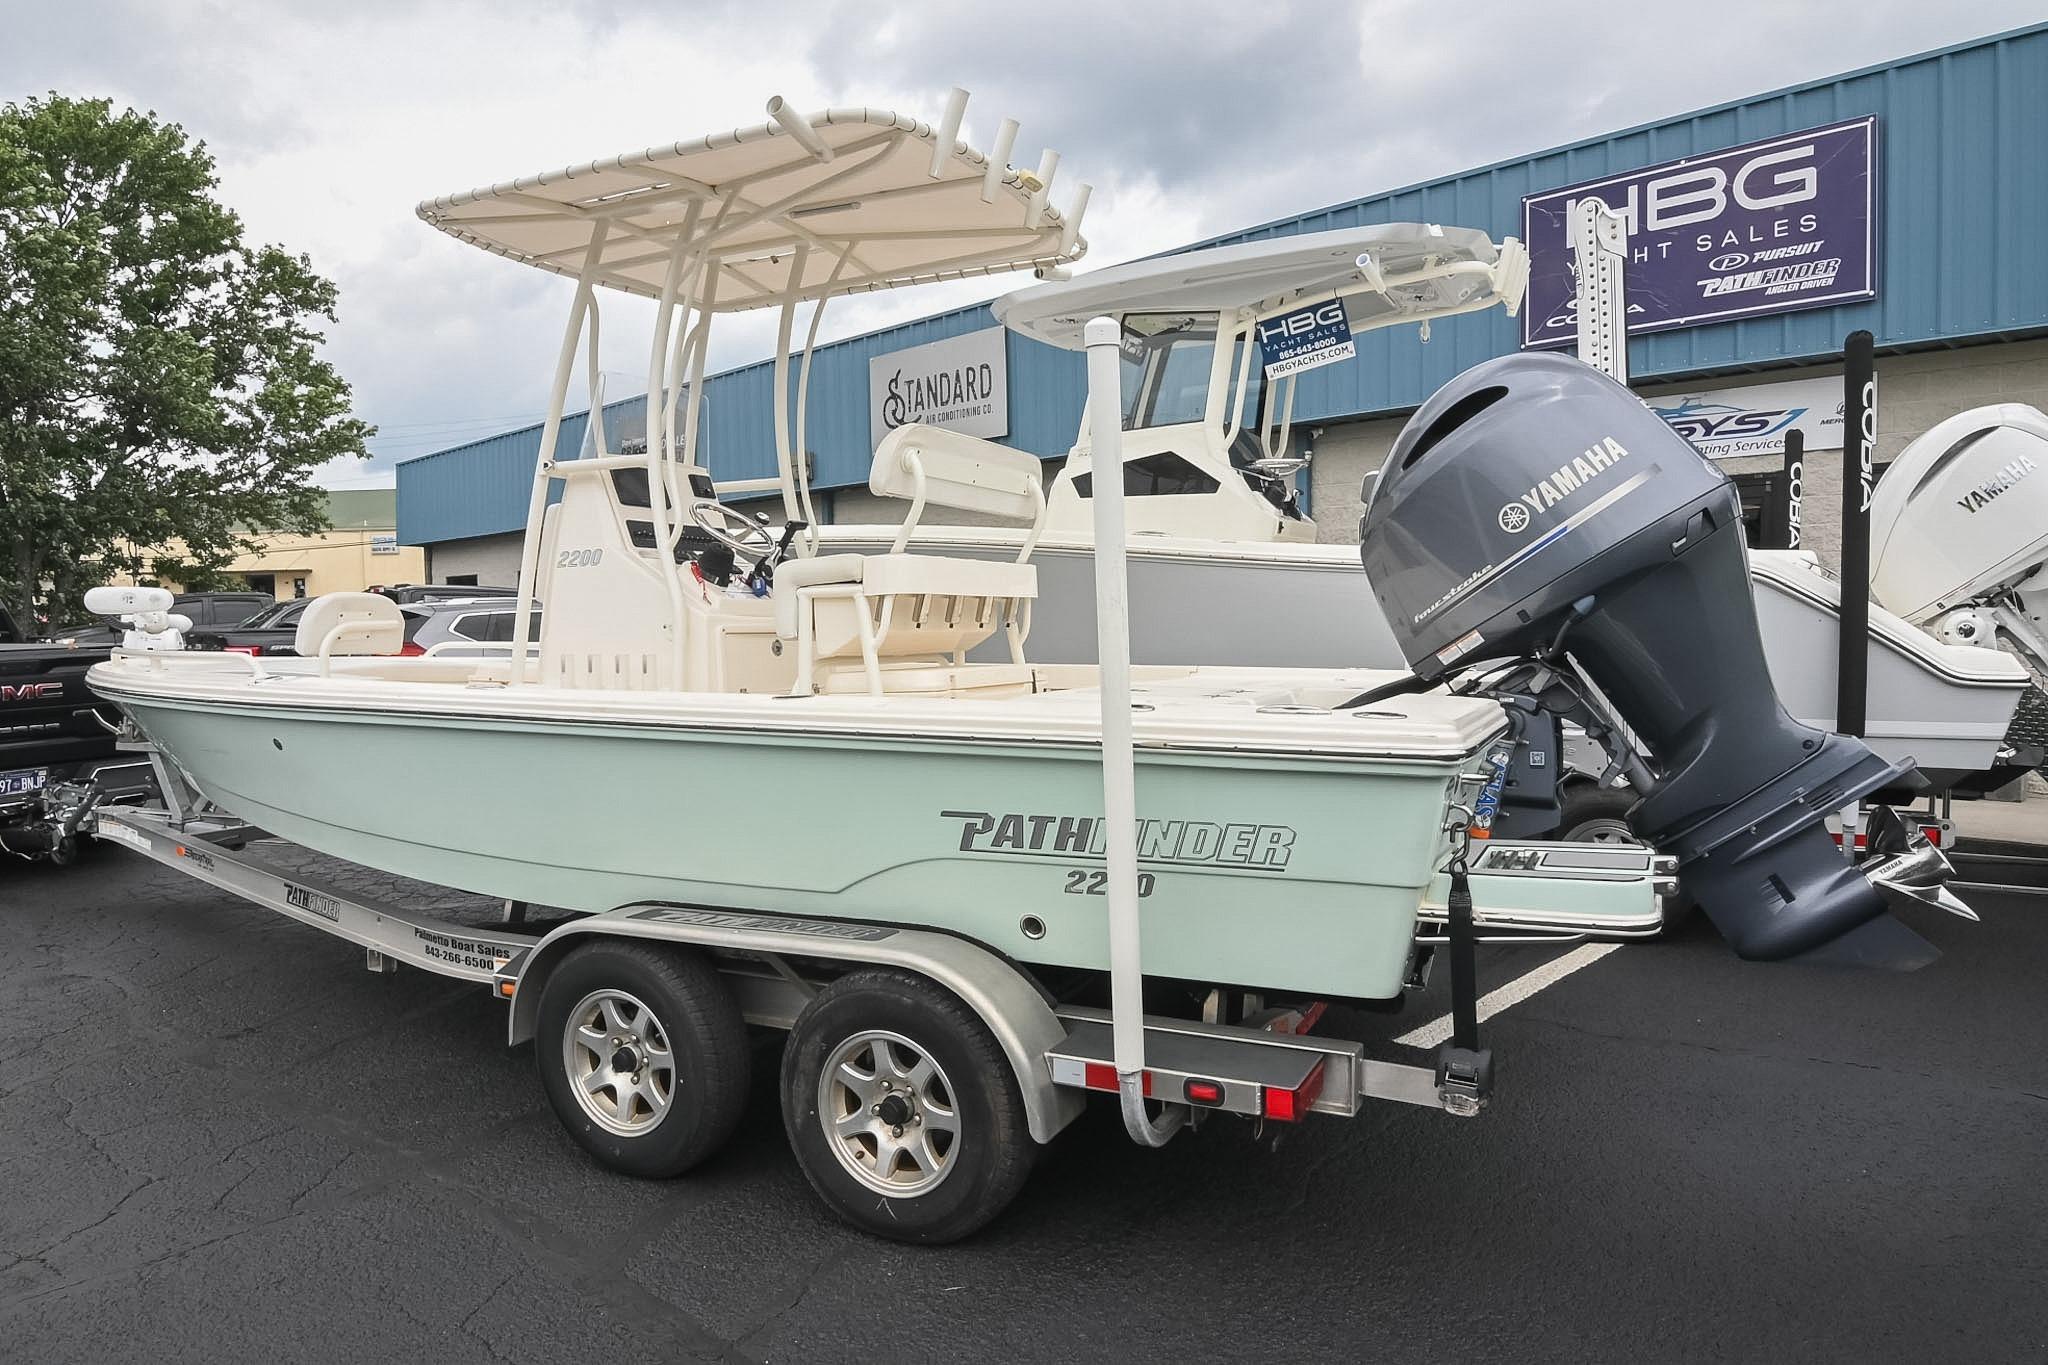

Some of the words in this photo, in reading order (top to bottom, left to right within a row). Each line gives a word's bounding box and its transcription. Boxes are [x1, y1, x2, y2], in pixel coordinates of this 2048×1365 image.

[1566, 144, 1817, 249] HBG
[1567, 242, 1673, 275] YHT
[1696, 214, 1818, 252] SALES
[1752, 240, 1825, 263] PURSUIT
[1696, 257, 1841, 298] PATHFINDER
[1765, 282, 1800, 296] ANGLER
[1801, 277, 1835, 290] DRIVEN
[1260, 303, 1344, 344] HBG
[1264, 336, 1303, 352] YACHT
[1308, 323, 1346, 340] SALES
[1272, 345, 1350, 375] HBGYACHTS.COM
[1278, 336, 1337, 360] 865-643-8000
[882, 362, 993, 430] STANDARD
[925, 414, 937, 425] AIR
[937, 405, 981, 423] CONDITIONING
[982, 403, 994, 415] CO.
[1860, 380, 1874, 513] COBIA
[1520, 436, 1629, 516] YAMAHA
[1957, 455, 2038, 514] YAMAHA
[1789, 461, 1803, 549] COBIA
[556, 548, 604, 569] 2200
[1414, 564, 1494, 624] fourstroke
[21, 775, 46, 791] BNJP
[940, 810, 1298, 868] PATHNDER
[1064, 869, 1156, 899] 220
[1879, 859, 1903, 875] YAMAHA
[283, 881, 341, 922] PATHFINDER
[414, 927, 450, 948] Palmetto
[451, 938, 475, 954] Boat
[477, 943, 510, 960] Sales
[424, 944, 494, 971] 843-266-6500
